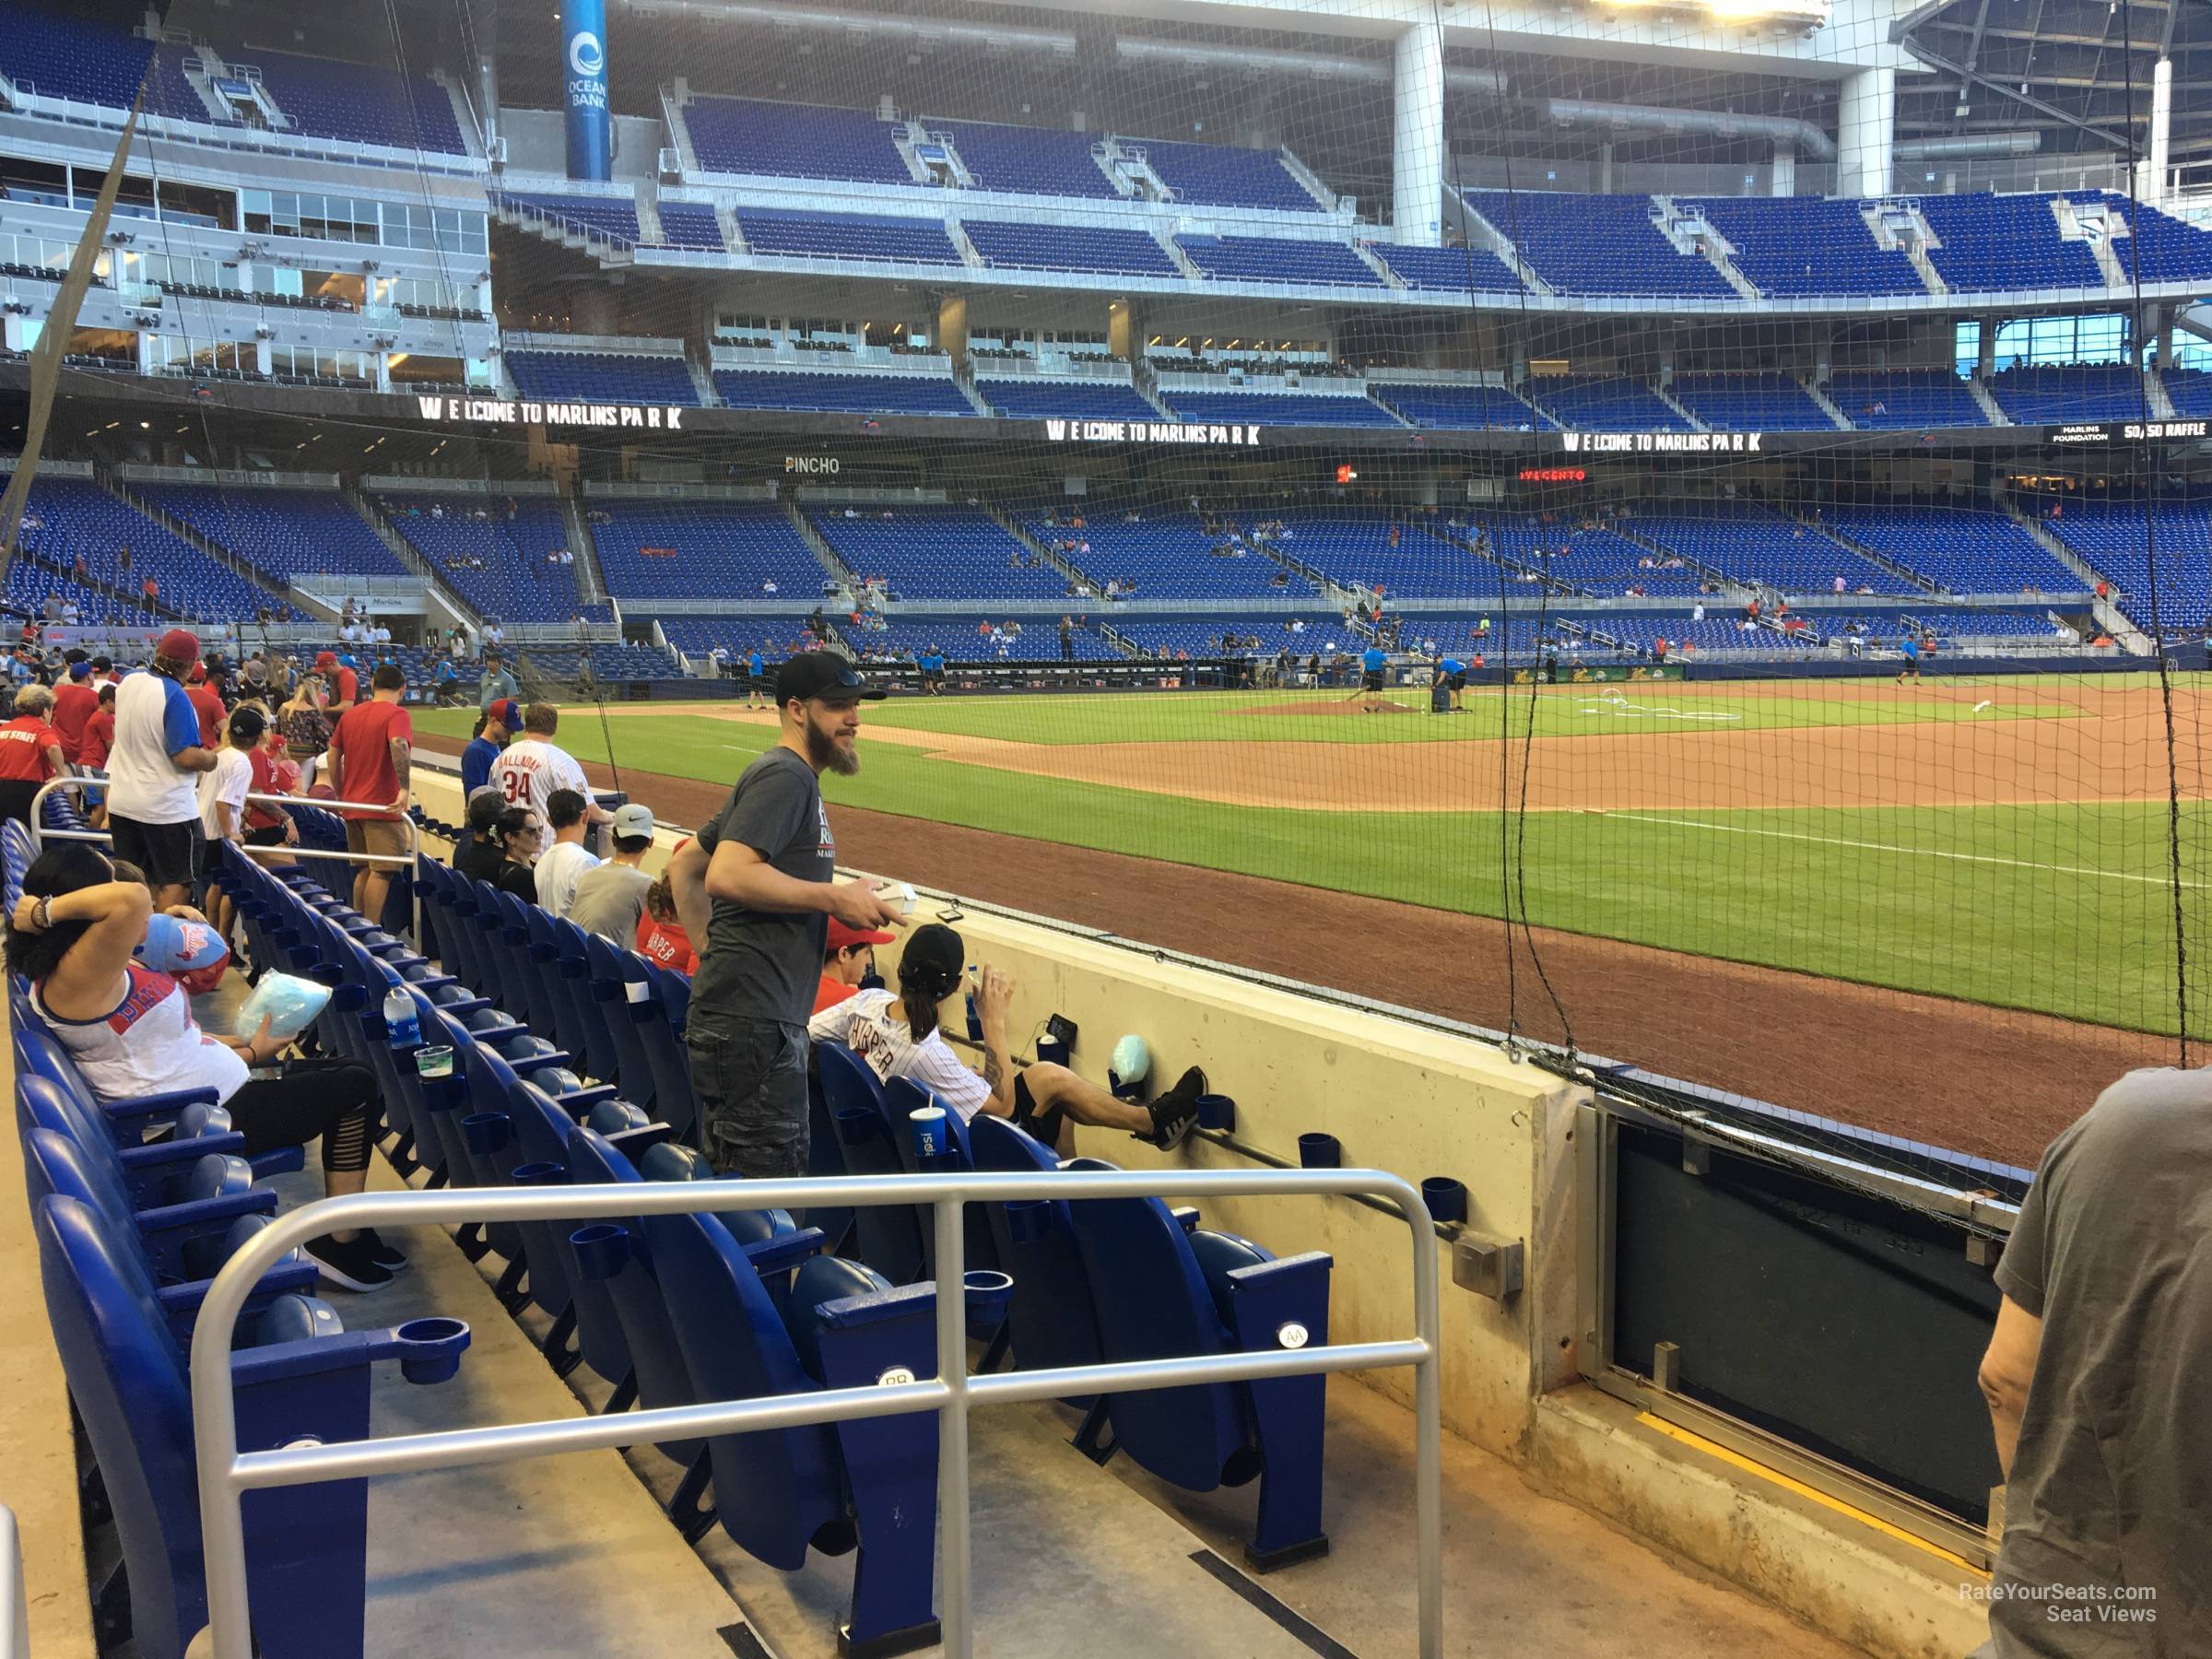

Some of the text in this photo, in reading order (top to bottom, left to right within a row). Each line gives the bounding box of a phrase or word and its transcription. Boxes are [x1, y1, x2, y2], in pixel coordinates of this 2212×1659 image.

[569, 79, 606, 98] OCEAN
[572, 93, 606, 110] BANK
[520, 402, 542, 424] TO
[546, 403, 618, 427] MARLINS
[1128, 423, 1147, 441] TO
[1149, 423, 1207, 443] MARLINS
[2053, 433, 2109, 442] FOUNDATION
[2063, 425, 2100, 434] MARLINS
[2165, 422, 2206, 437] RAFFLE
[1636, 434, 1653, 452] TO
[1655, 433, 1710, 451] MARLINS
[785, 456, 840, 474] PINCHO
[498, 755, 542, 773] HALLADAY
[503, 770, 532, 806] 34
